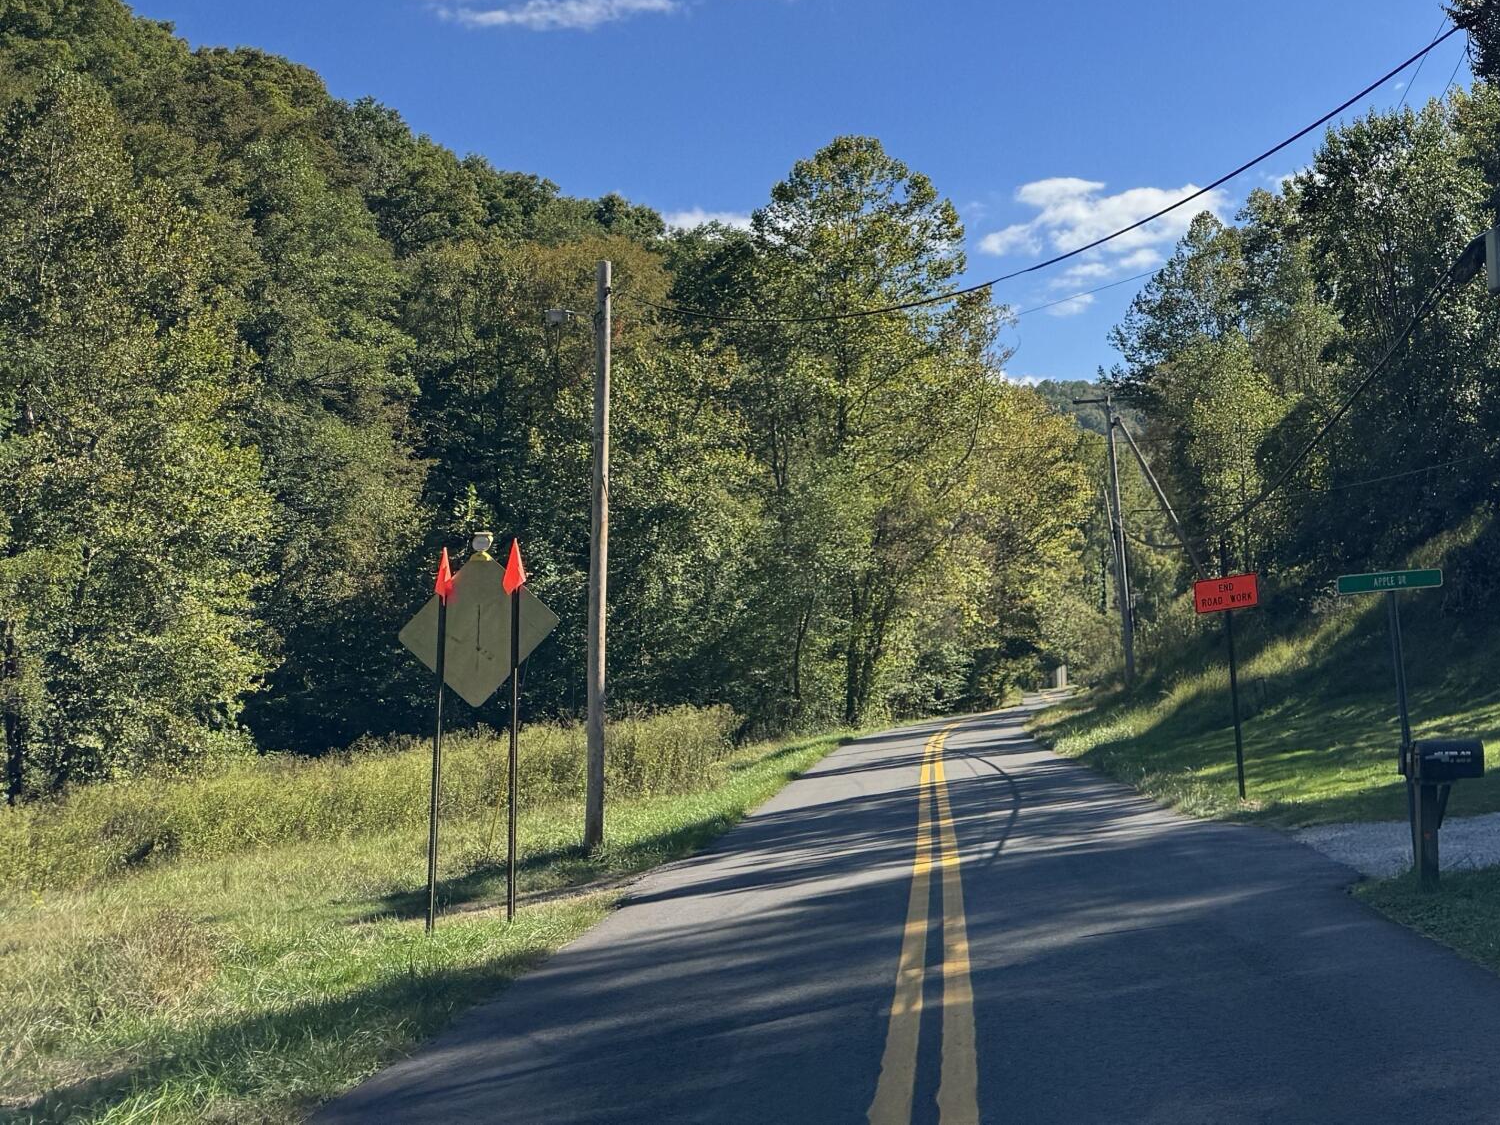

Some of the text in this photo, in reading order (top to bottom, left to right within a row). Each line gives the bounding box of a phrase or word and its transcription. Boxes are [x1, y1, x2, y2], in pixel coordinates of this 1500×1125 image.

[1373, 575, 1407, 587] APPLE DR
[1218, 583, 1233, 592] END
[1201, 592, 1252, 607] ROAD WORK
